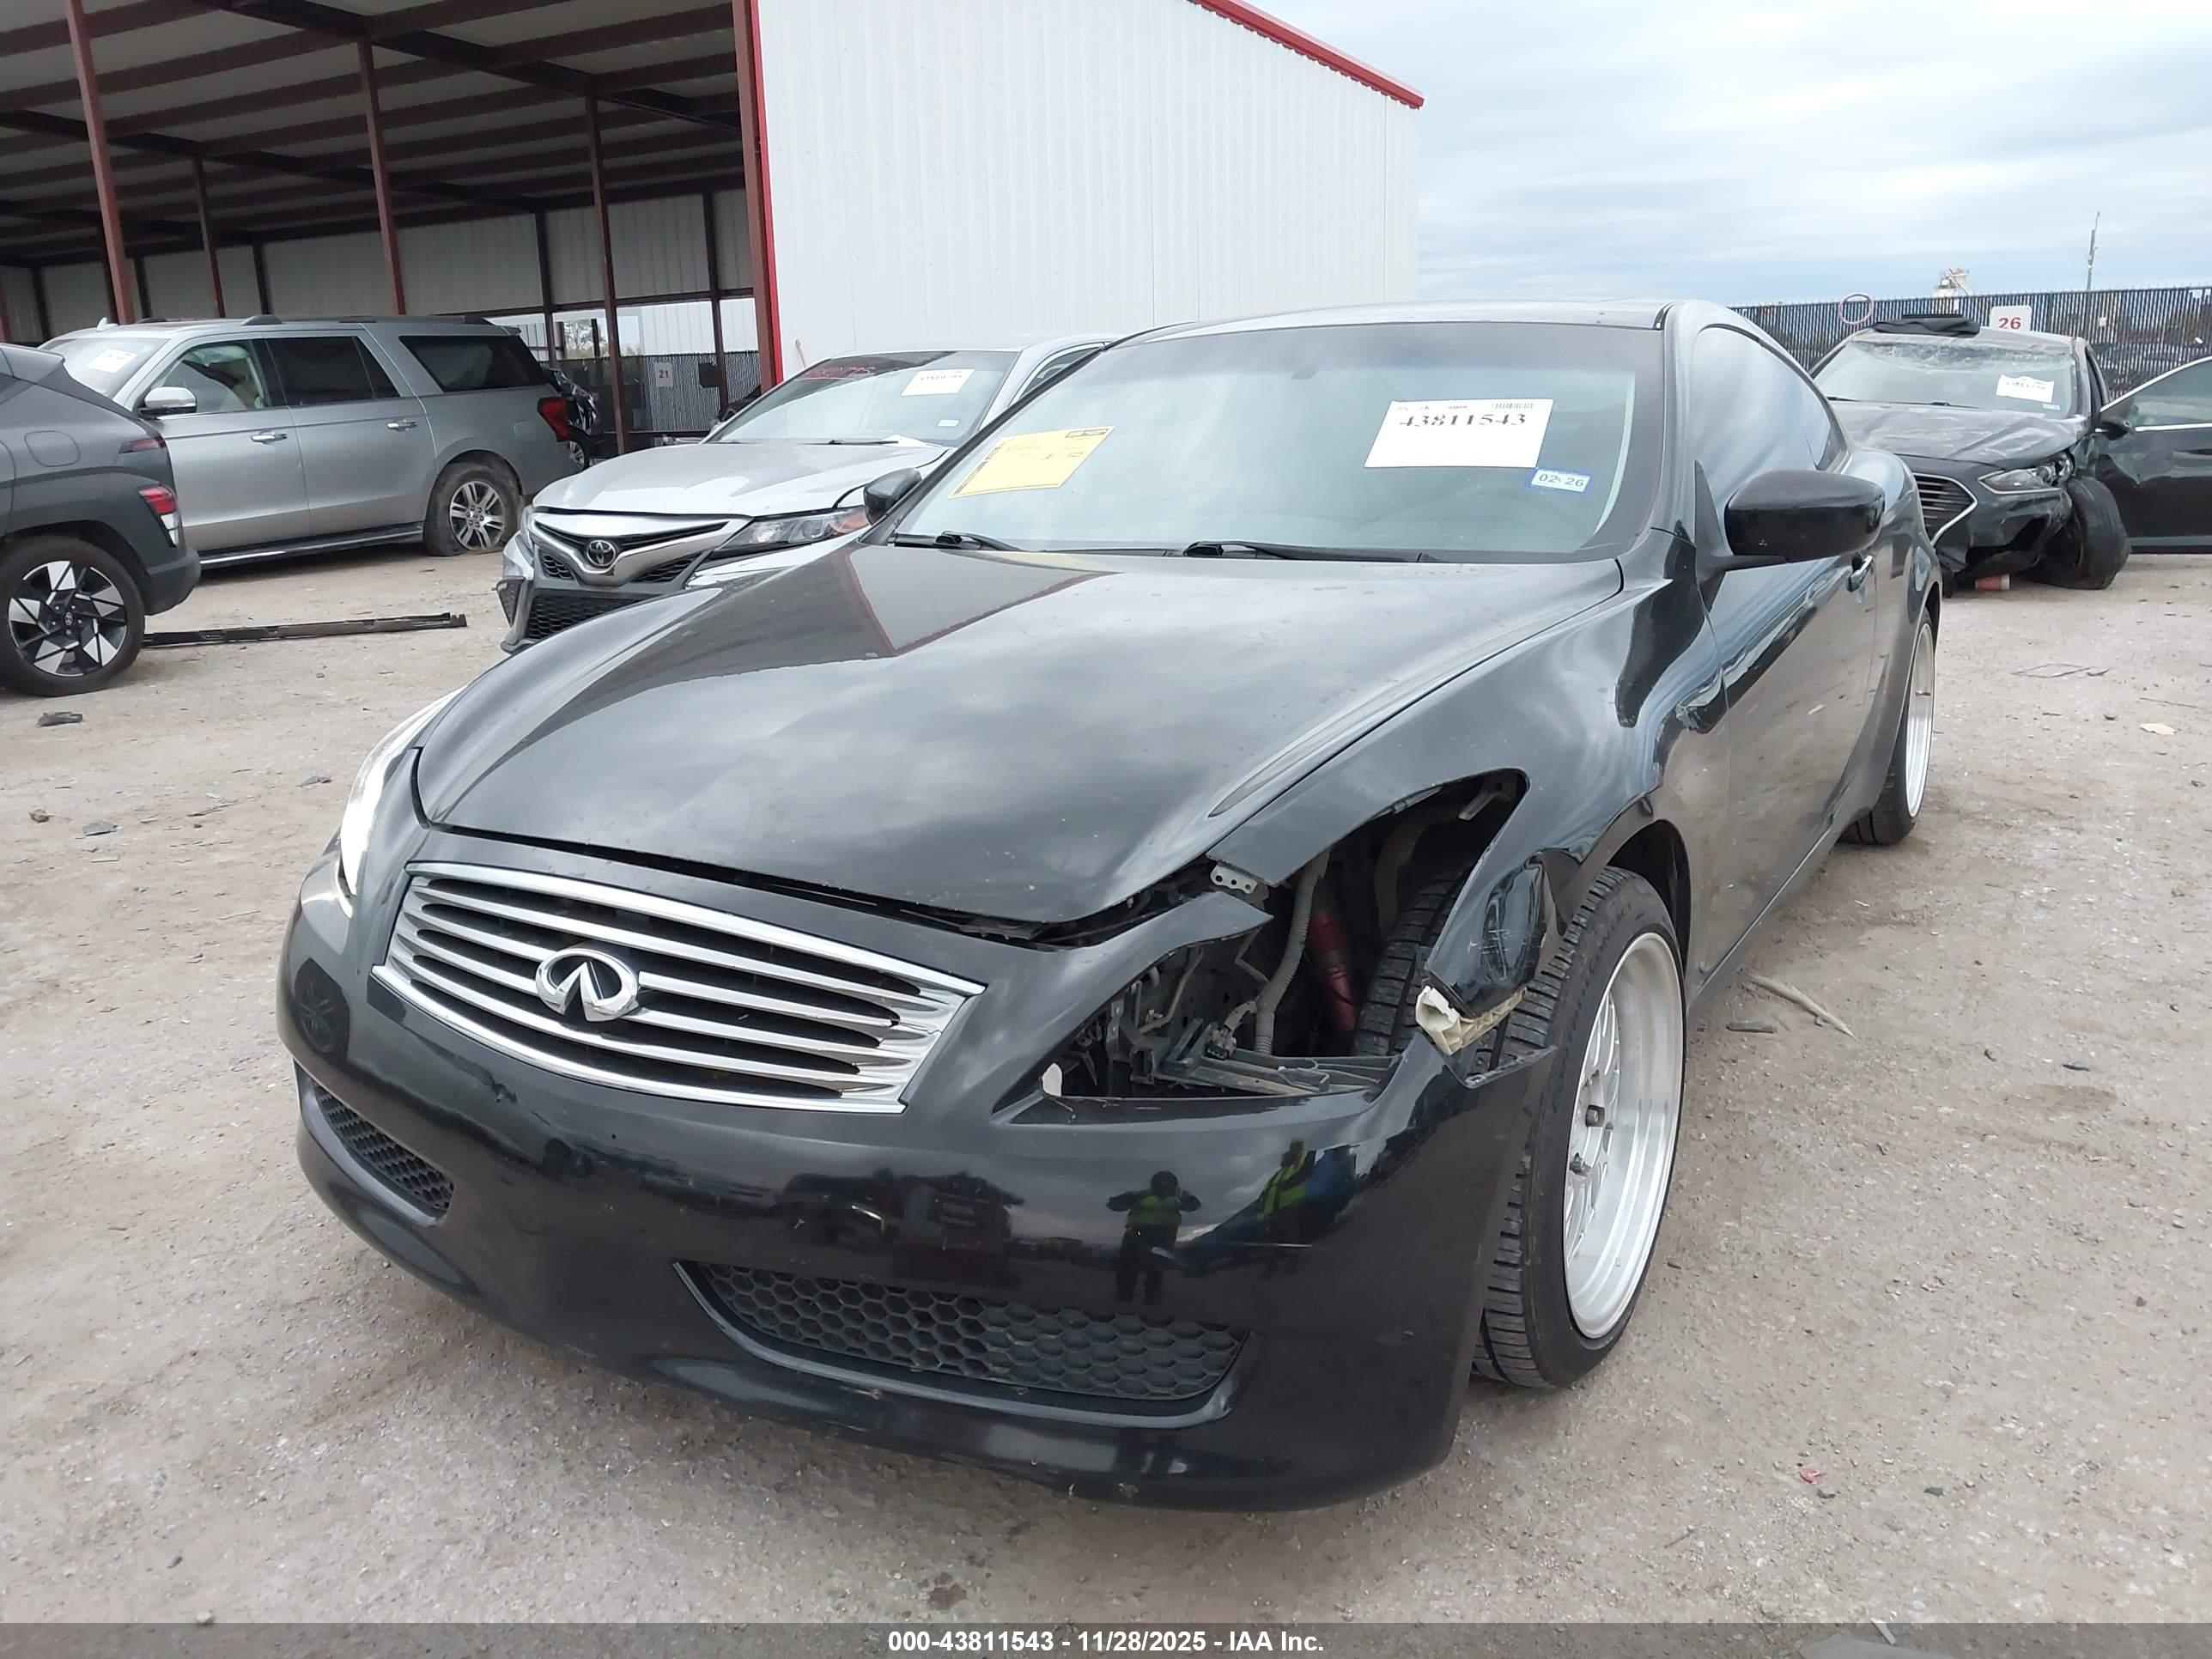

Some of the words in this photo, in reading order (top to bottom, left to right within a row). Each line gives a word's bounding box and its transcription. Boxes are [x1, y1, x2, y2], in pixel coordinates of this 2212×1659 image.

[1998, 317, 2021, 330] 26
[659, 369, 669, 379] 21
[1399, 413, 1526, 428] 43811543
